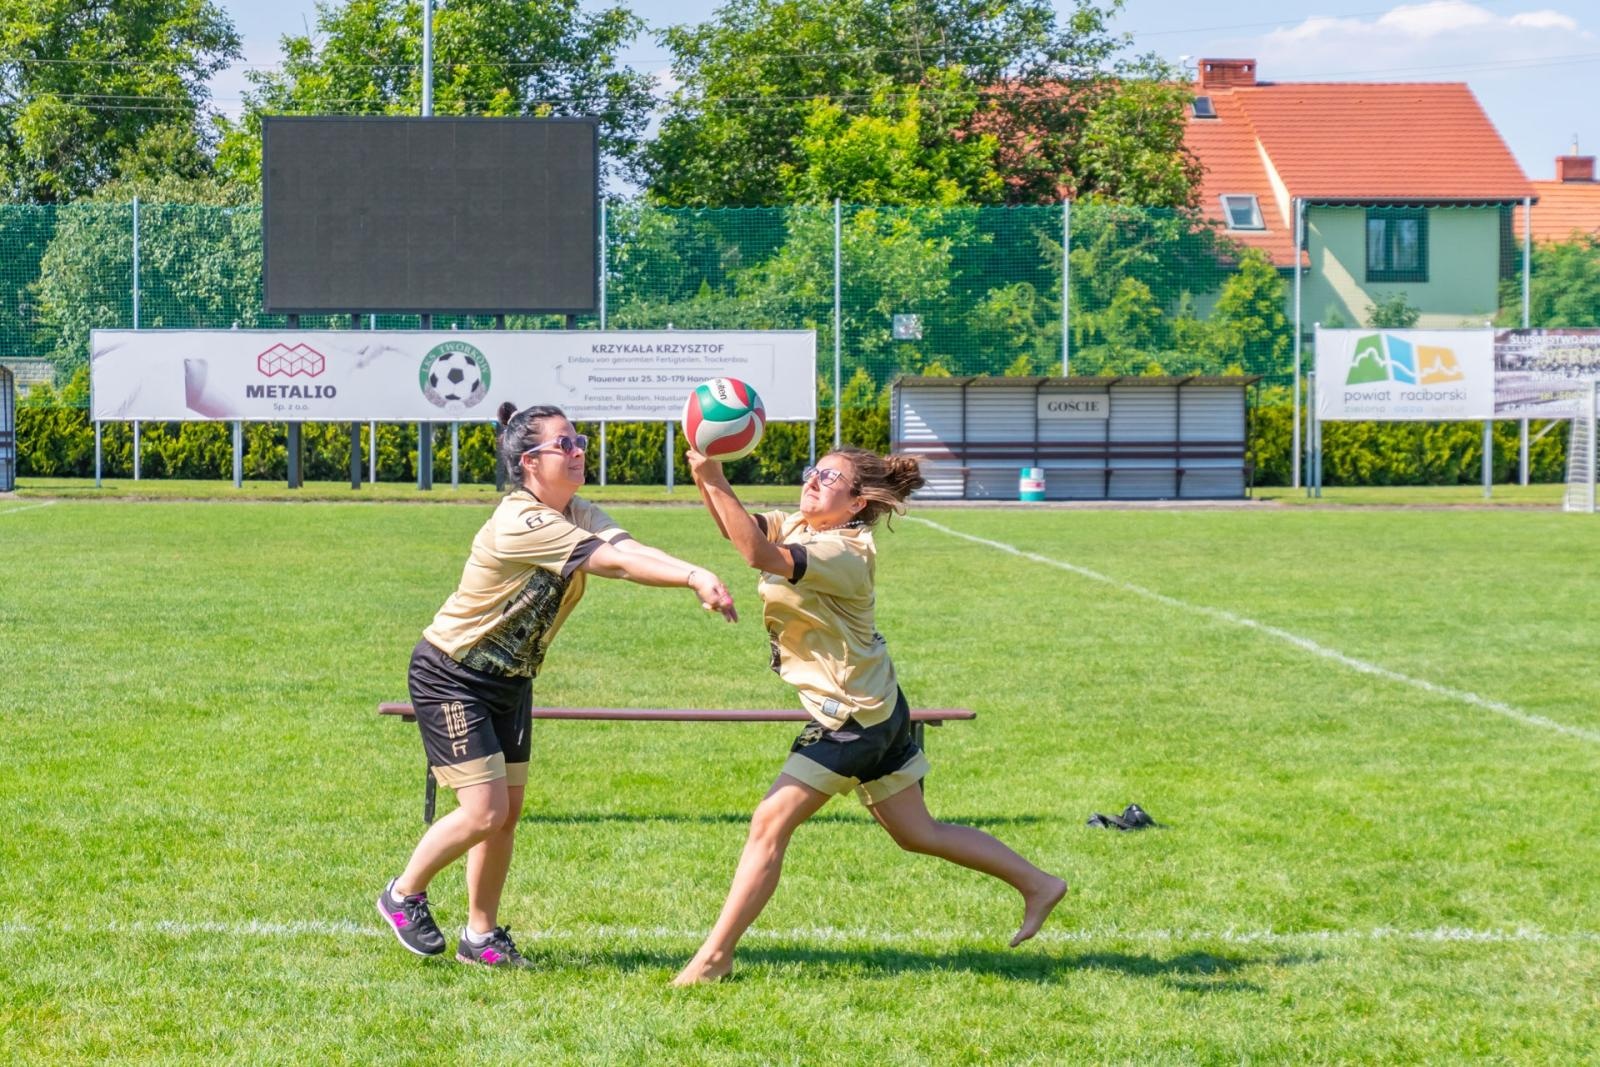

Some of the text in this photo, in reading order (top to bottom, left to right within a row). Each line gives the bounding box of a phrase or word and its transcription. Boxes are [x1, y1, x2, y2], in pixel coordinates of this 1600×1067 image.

[592, 344, 725, 353] KRZYKAŁA KRZYSZTOF
[704, 355, 748, 363] Trockenbau
[588, 374, 626, 383] Plauener
[656, 375, 685, 383] 30-179
[246, 384, 337, 398] METALIO
[1344, 388, 1467, 404] powiat raciborski
[1047, 399, 1100, 412] GOŚCIE
